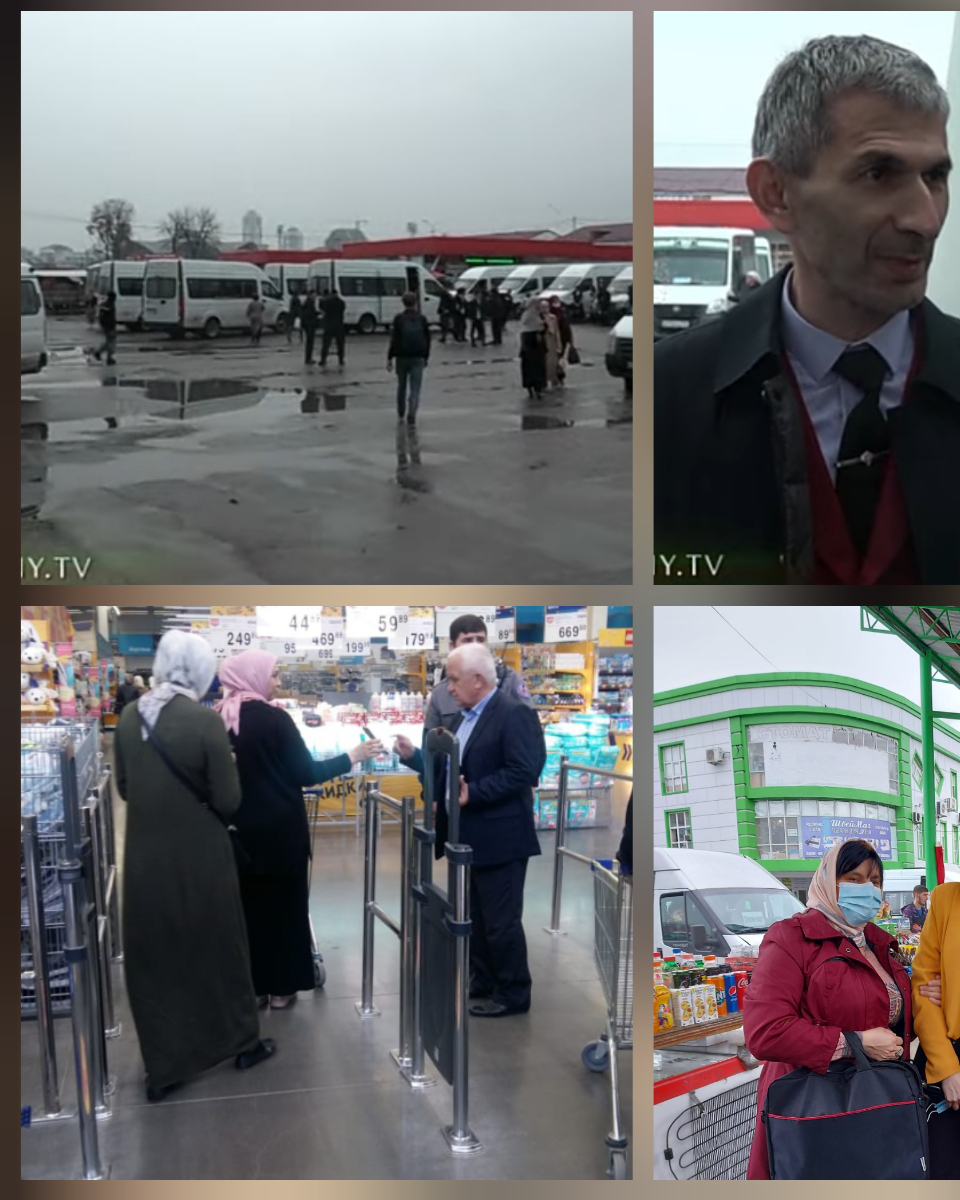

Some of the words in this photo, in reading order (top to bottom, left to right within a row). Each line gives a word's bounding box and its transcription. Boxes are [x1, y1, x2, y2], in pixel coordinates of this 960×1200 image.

[378, 615, 398, 632] 59
[227, 631, 251, 646] 249
[559, 626, 579, 639] 669
[758, 725, 831, 740] СТОМАТ
